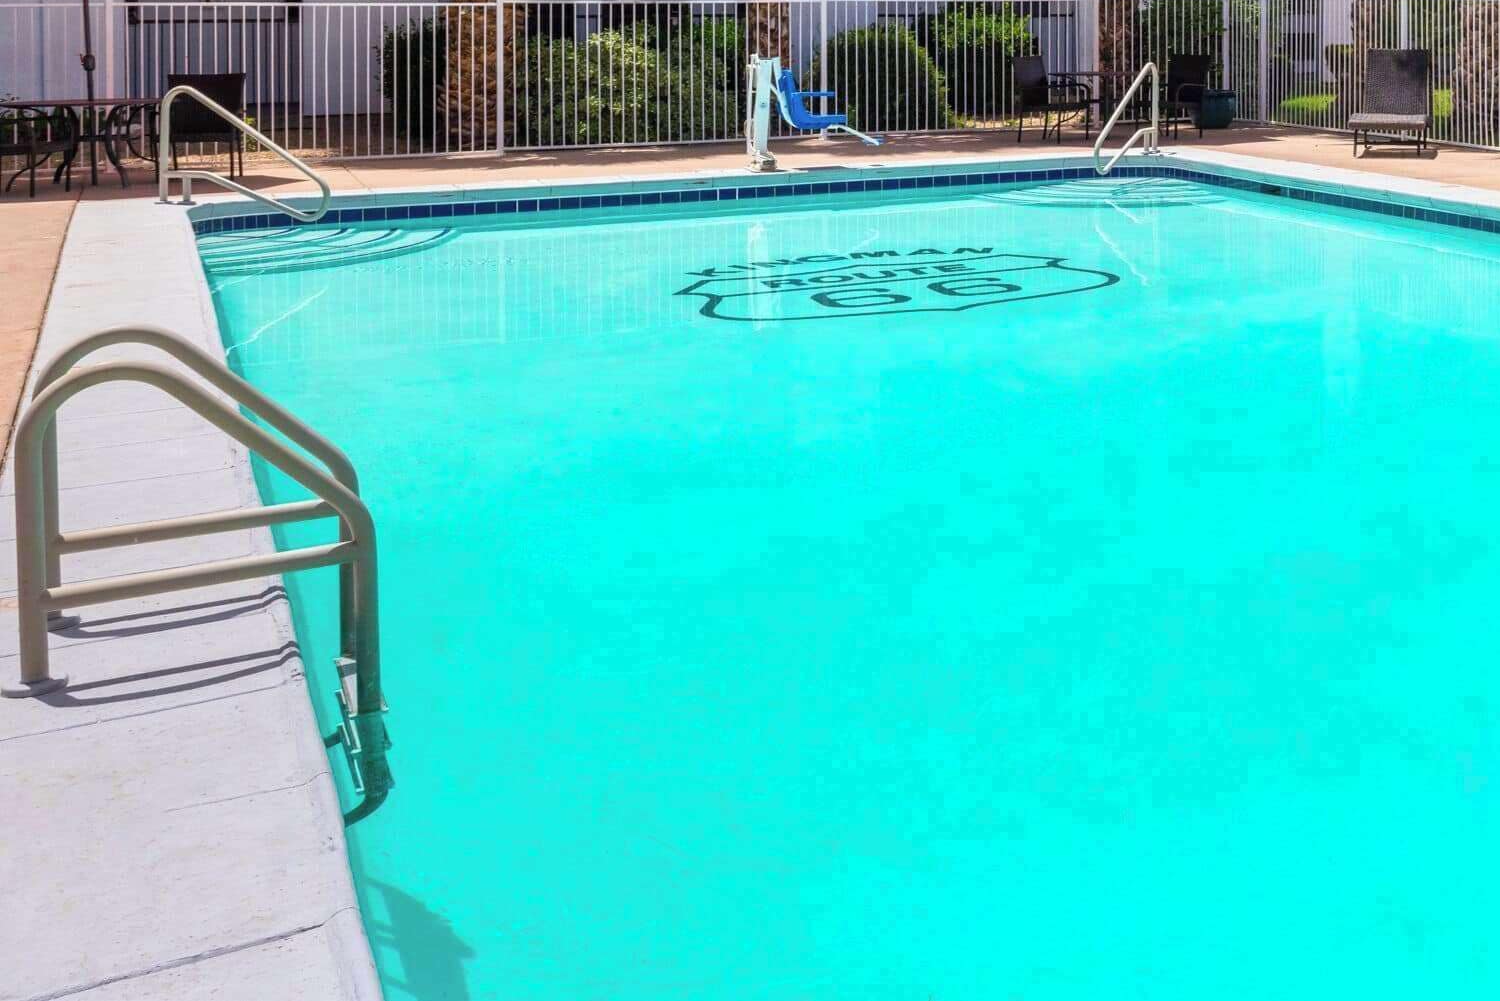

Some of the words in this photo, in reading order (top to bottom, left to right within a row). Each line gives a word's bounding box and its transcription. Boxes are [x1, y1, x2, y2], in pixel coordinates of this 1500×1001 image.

[685, 247, 994, 277] KINGMAN
[761, 264, 976, 289] ROUTE
[810, 277, 1023, 309] 66
